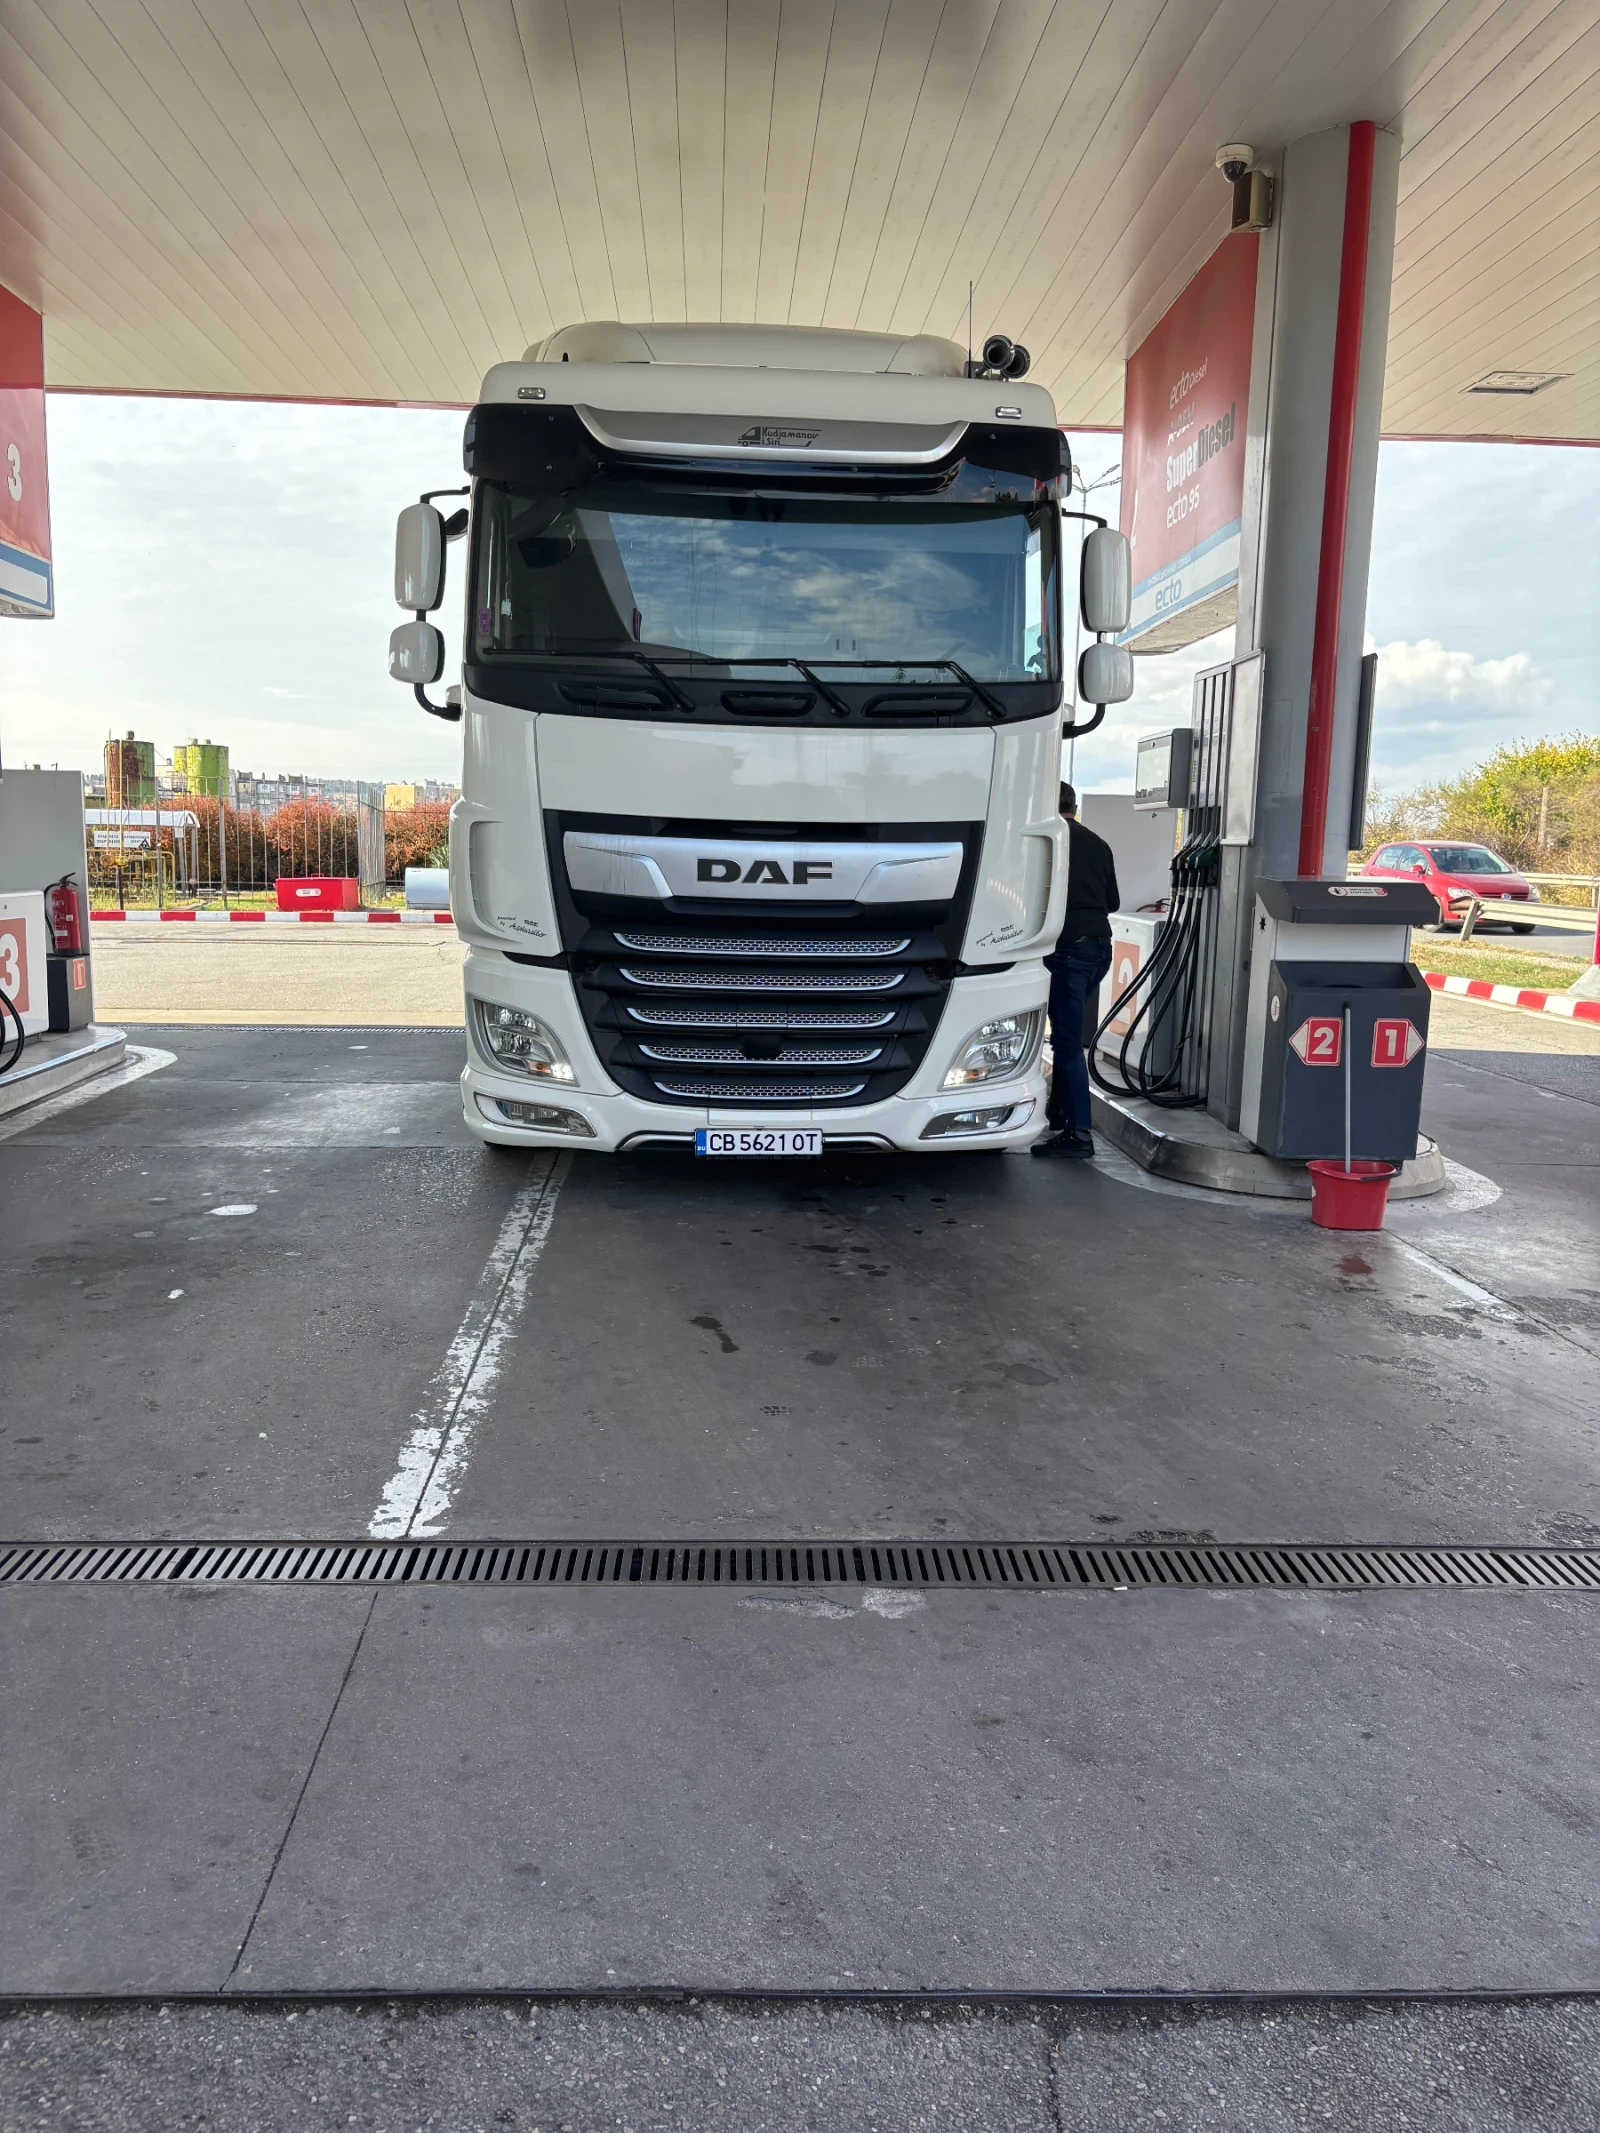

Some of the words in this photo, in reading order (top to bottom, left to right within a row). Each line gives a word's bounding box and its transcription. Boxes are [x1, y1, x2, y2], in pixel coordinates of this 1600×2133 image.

[762, 427, 818, 440] Kudjamanov
[7, 443, 22, 501] 3
[1167, 491, 1187, 528] ecto
[1189, 484, 1200, 513] 95
[1155, 578, 1182, 611] ecto
[697, 858, 833, 884] DAF
[1312, 1027, 1334, 1055] 2
[1385, 1029, 1398, 1057] 1
[709, 1134, 735, 1151] CB
[740, 1134, 785, 1151] 5621
